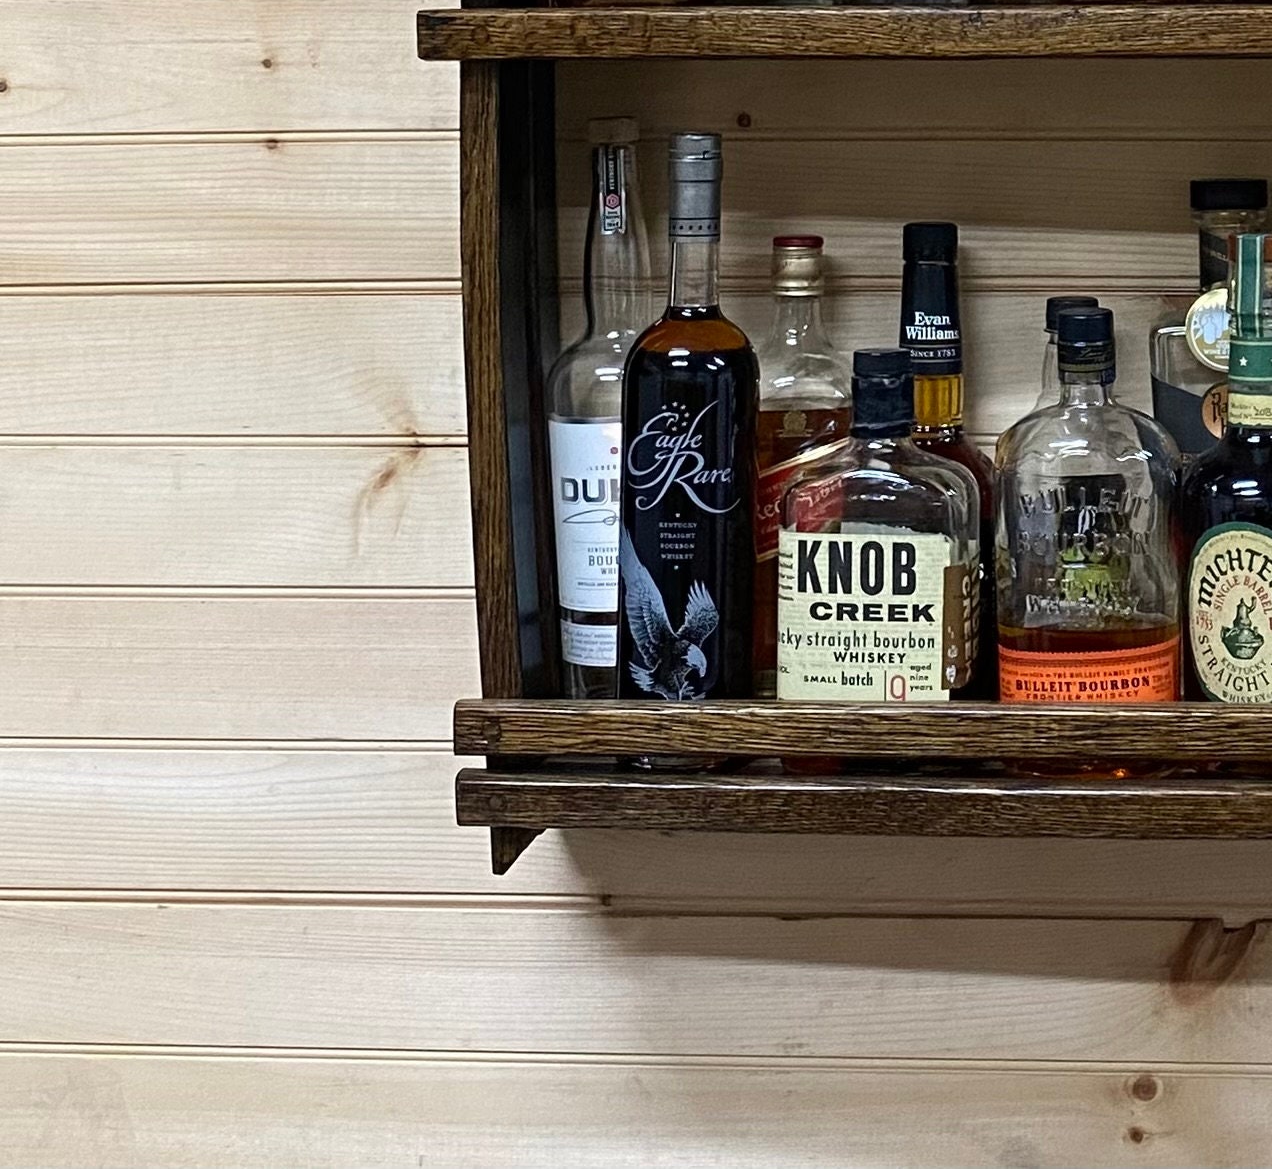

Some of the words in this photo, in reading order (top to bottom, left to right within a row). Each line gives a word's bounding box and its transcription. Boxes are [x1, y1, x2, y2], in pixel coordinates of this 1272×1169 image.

[914, 310, 951, 326] Evan
[905, 325, 960, 340] Williams
[627, 400, 719, 482] Eagle
[635, 451, 741, 513] Rare
[797, 539, 917, 597] KNOB
[1213, 575, 1241, 612] SINGLE
[808, 602, 936, 623] CREEK
[806, 631, 869, 652] straight
[873, 630, 936, 649] bourbon
[833, 651, 908, 664] WHISKEY
[1199, 634, 1271, 693] STRAIGHT
[1220, 656, 1268, 674] KENTUCKY
[909, 662, 933, 671] aged
[803, 674, 838, 684] SMALL
[841, 671, 874, 687] batch
[909, 673, 930, 681] nine
[1015, 679, 1074, 692] BULLEIT
[1078, 675, 1151, 692] BOURBON
[909, 683, 934, 692] years
[1026, 692, 1082, 700] FRONTIER
[1086, 690, 1140, 700] WHISKEY
